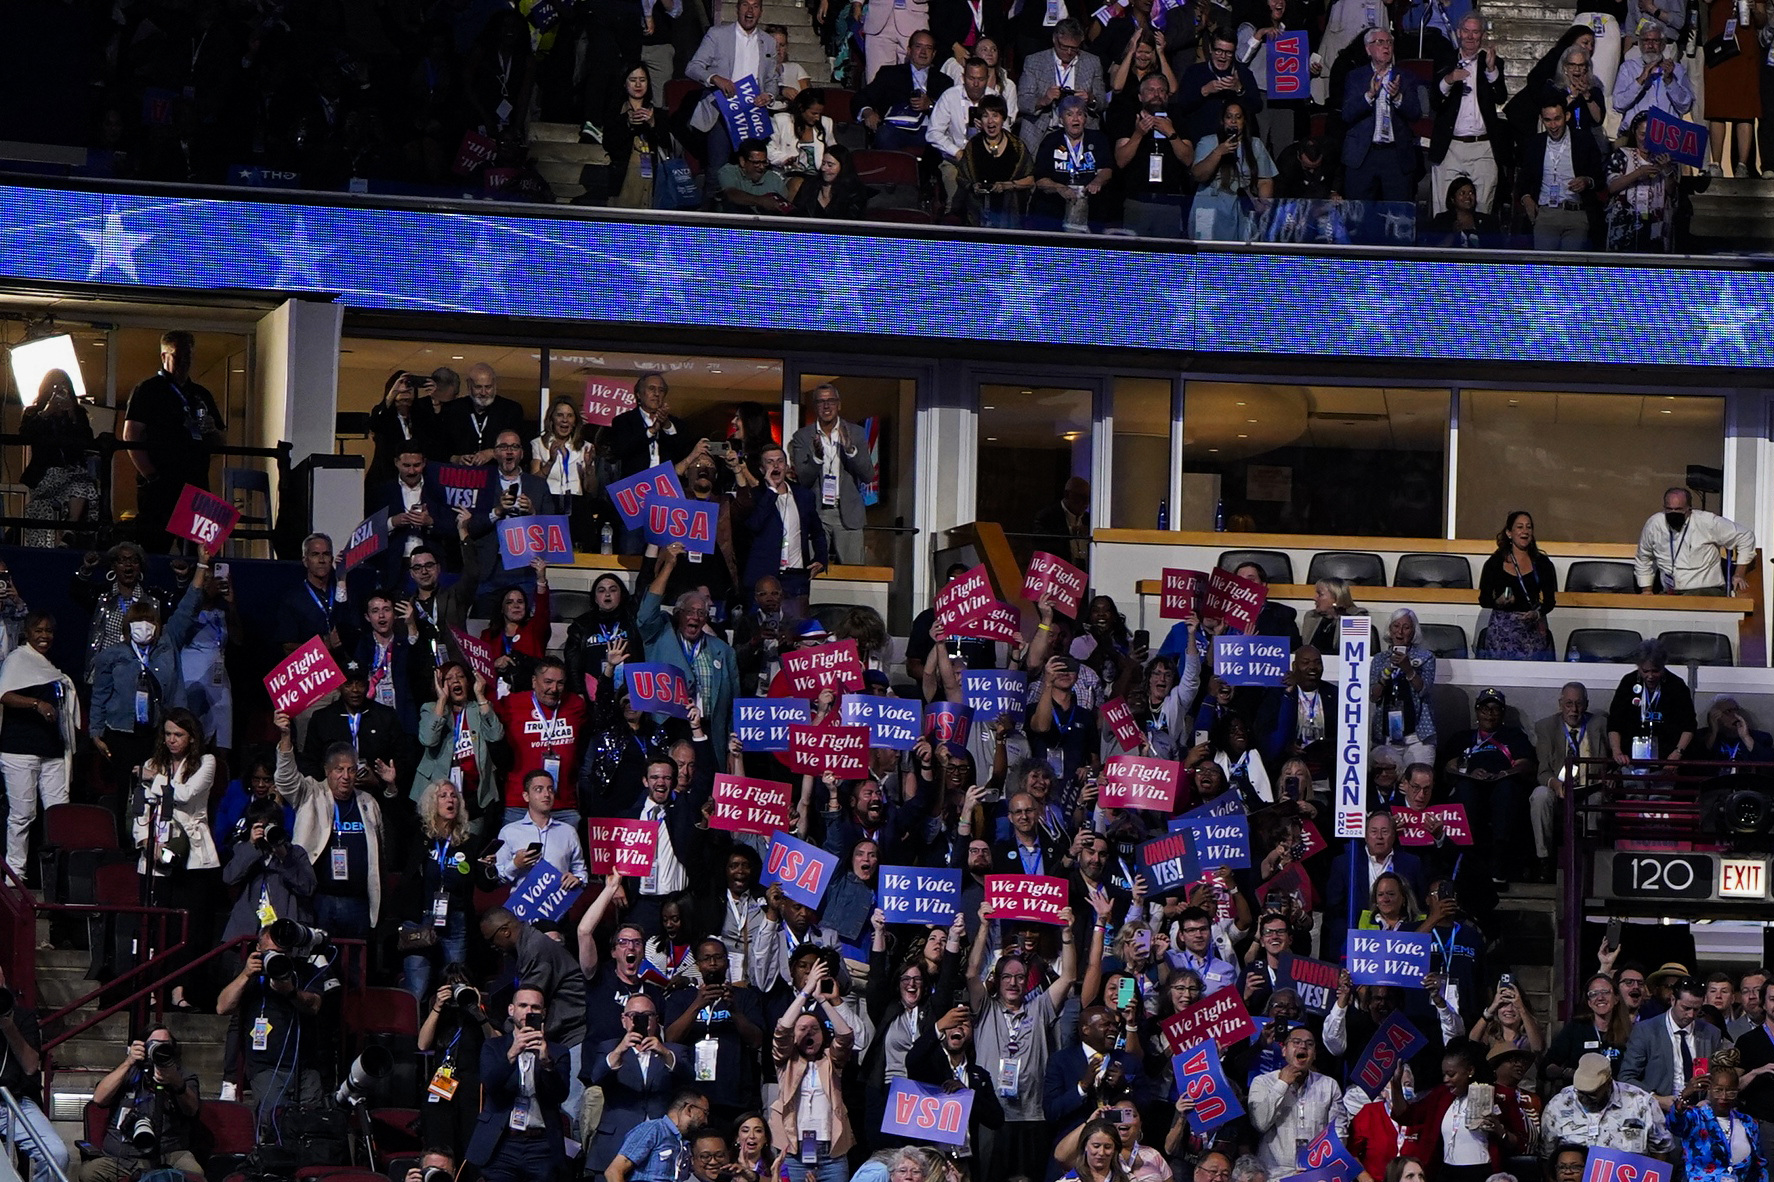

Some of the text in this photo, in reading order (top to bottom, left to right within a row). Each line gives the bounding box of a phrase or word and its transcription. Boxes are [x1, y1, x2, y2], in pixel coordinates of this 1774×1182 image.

[1275, 37, 1300, 93] USA
[1650, 119, 1697, 152] USA
[649, 505, 709, 541] USA
[1219, 643, 1285, 658] We Vote,
[269, 648, 324, 693] We Fight,
[1214, 662, 1284, 676] We Win.
[274, 668, 335, 713] We Win.
[634, 671, 694, 707] USA
[1344, 640, 1366, 806] MICHIGAN
[795, 732, 863, 752] We Fight,
[796, 751, 863, 768] We Win.
[1144, 834, 1184, 866] UNION
[768, 843, 823, 893] USA
[885, 874, 955, 893] We Vote,
[1155, 858, 1184, 884] YES!
[1632, 858, 1694, 890] 120
[1724, 864, 1762, 891] EXIT
[884, 896, 954, 913] We Win.
[1361, 1027, 1412, 1087] USA
[1182, 1050, 1226, 1121] USA
[895, 1093, 962, 1133] USA
